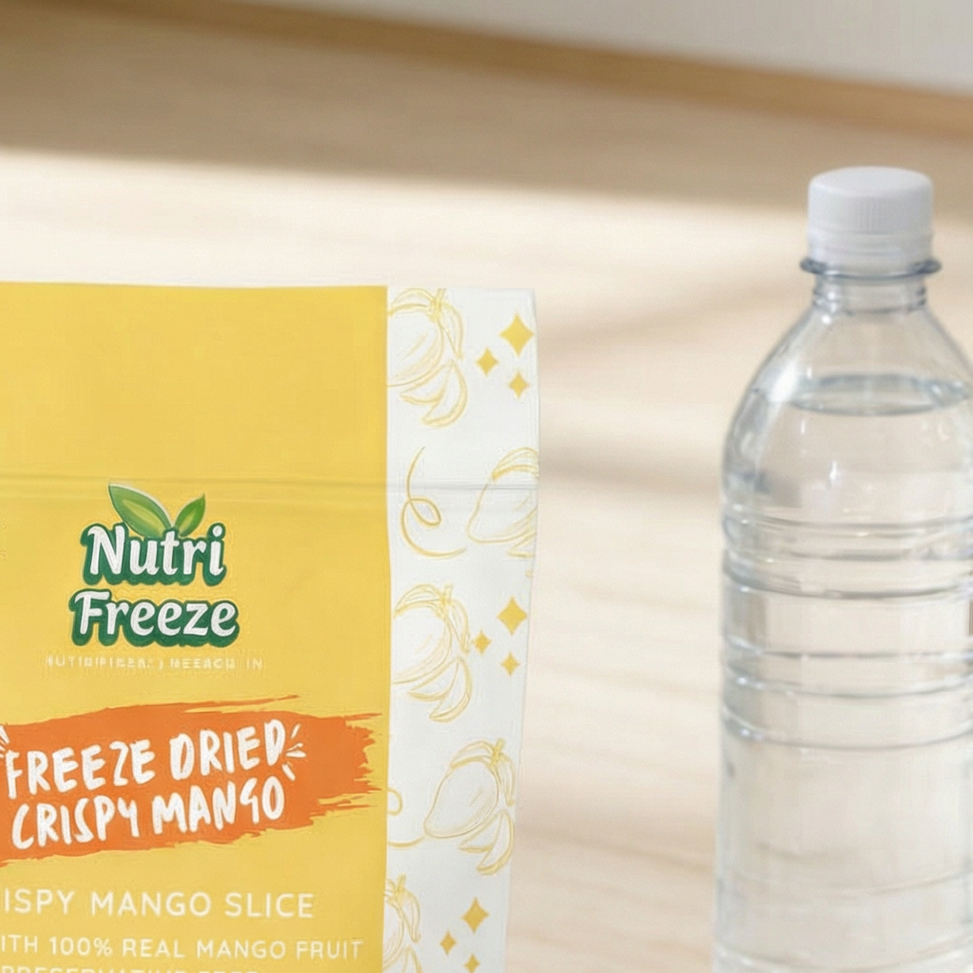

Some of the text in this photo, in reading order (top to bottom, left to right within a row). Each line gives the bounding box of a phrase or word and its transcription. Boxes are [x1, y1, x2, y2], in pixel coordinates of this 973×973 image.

[83, 524, 226, 582] Nutri
[71, 590, 238, 642] Freeze
[5, 718, 286, 799] FREEZE DRIED
[11, 777, 286, 850] CRISPY MANGO
[90, 891, 212, 917] MANGO
[224, 892, 315, 918] SLICE
[49, 936, 113, 957] 100%
[121, 938, 186, 958] REAL
[196, 939, 287, 960] MANGO
[295, 939, 364, 961] FRUIT
